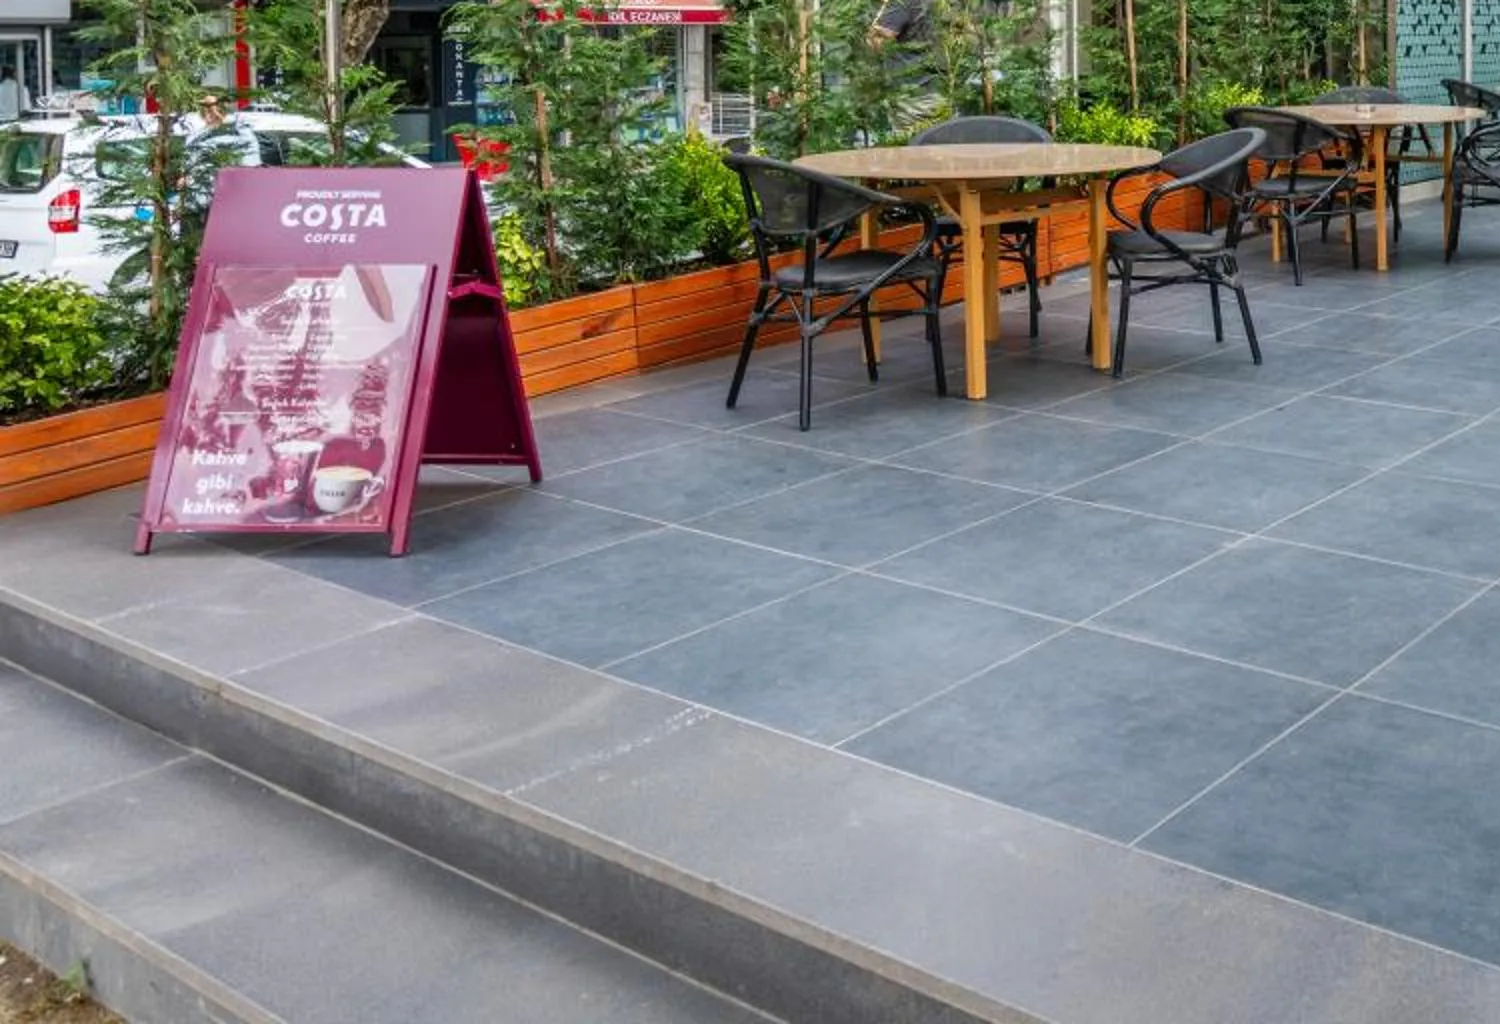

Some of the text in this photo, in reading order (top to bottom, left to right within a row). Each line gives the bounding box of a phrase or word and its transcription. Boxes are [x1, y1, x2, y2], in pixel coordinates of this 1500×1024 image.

[280, 203, 387, 230] COSTA
[304, 233, 357, 243] COFFEE
[286, 284, 347, 301] COSTA
[192, 449, 248, 466] Kahve
[196, 477, 233, 495] gibi
[182, 498, 241, 515] kahve.
